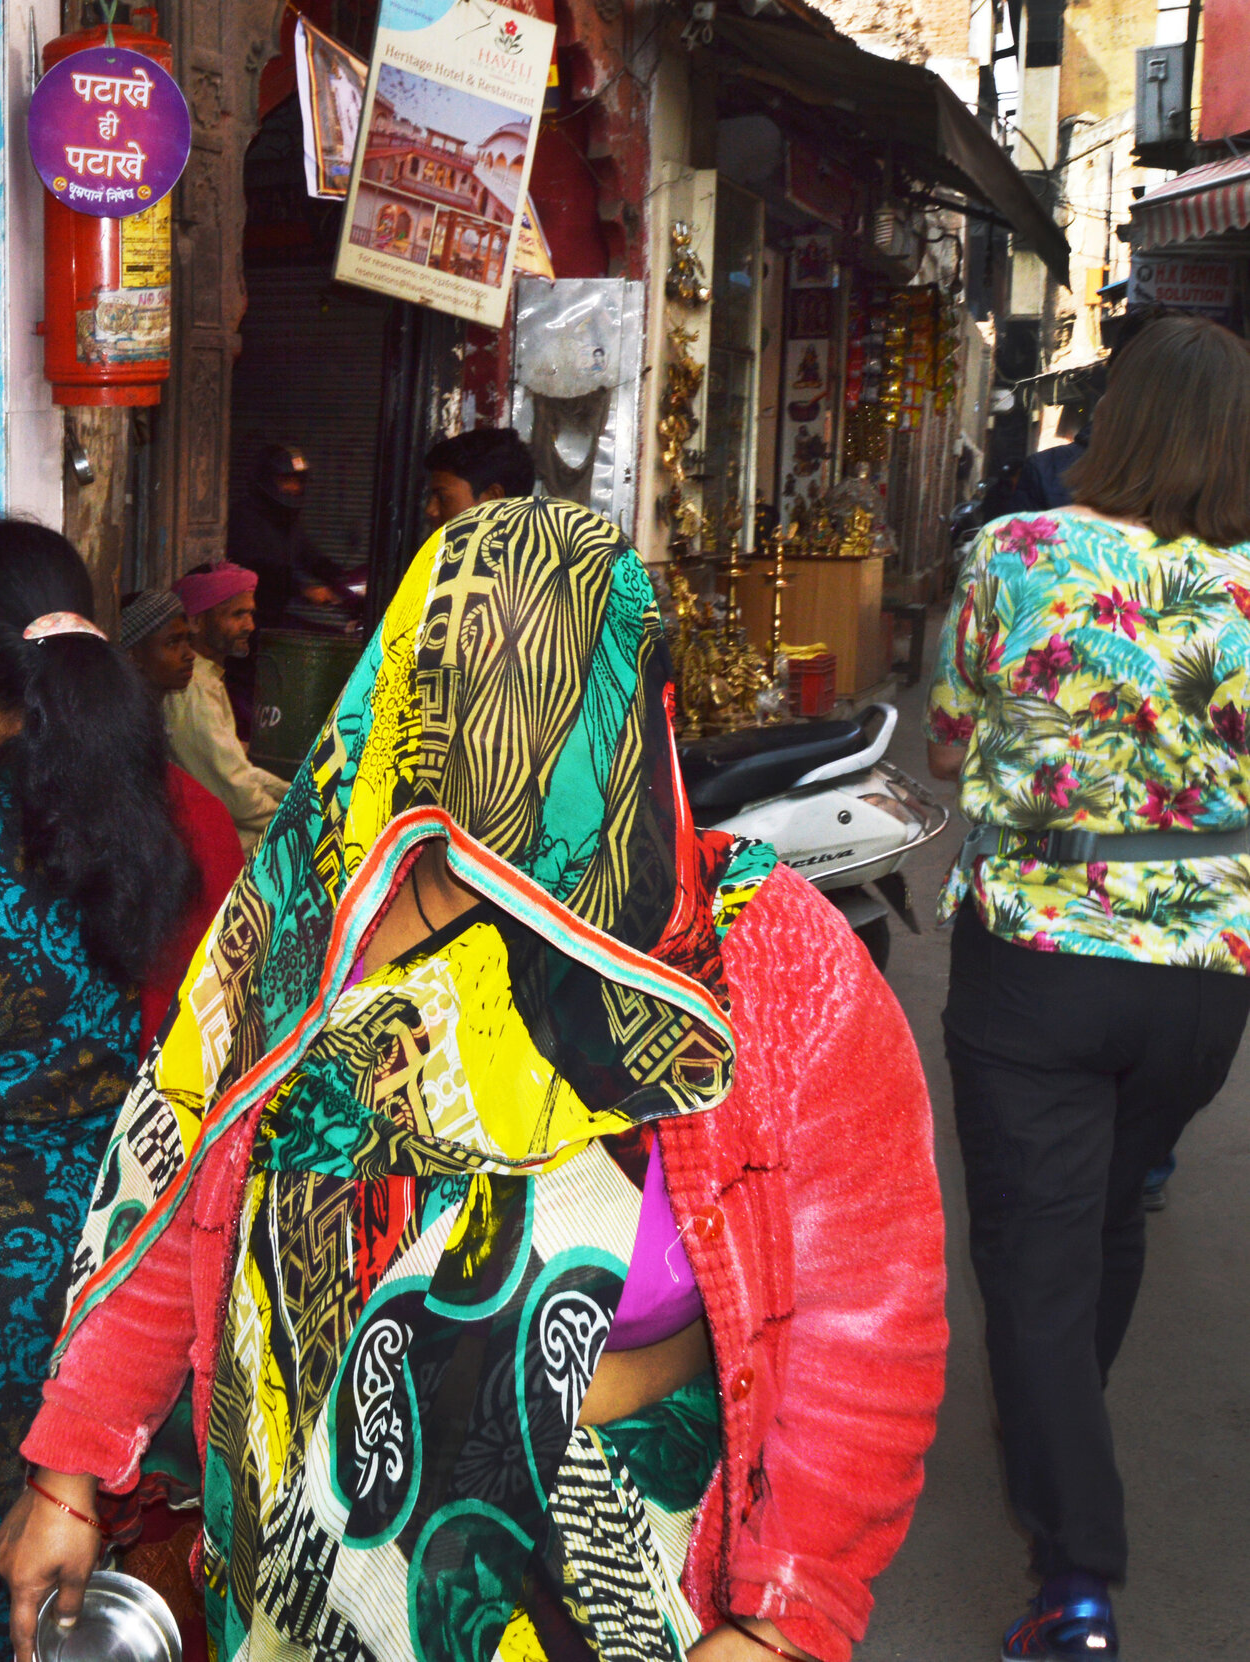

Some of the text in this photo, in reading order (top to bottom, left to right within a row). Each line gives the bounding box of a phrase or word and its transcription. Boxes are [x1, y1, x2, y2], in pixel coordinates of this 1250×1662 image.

[385, 44, 433, 73] Heritage
[435, 61, 464, 83] Hotel
[467, 75, 475, 87] &
[478, 77, 535, 107] Restaurant
[478, 48, 533, 78] HAVELI
[71, 68, 153, 108] पटाखे
[98, 110, 119, 140] ही
[65, 141, 146, 180] पटाखे
[68, 182, 134, 203] धूम्रपान निषेध
[1181, 264, 1230, 286] DENTAL
[1155, 287, 1225, 302] SOLUTION
